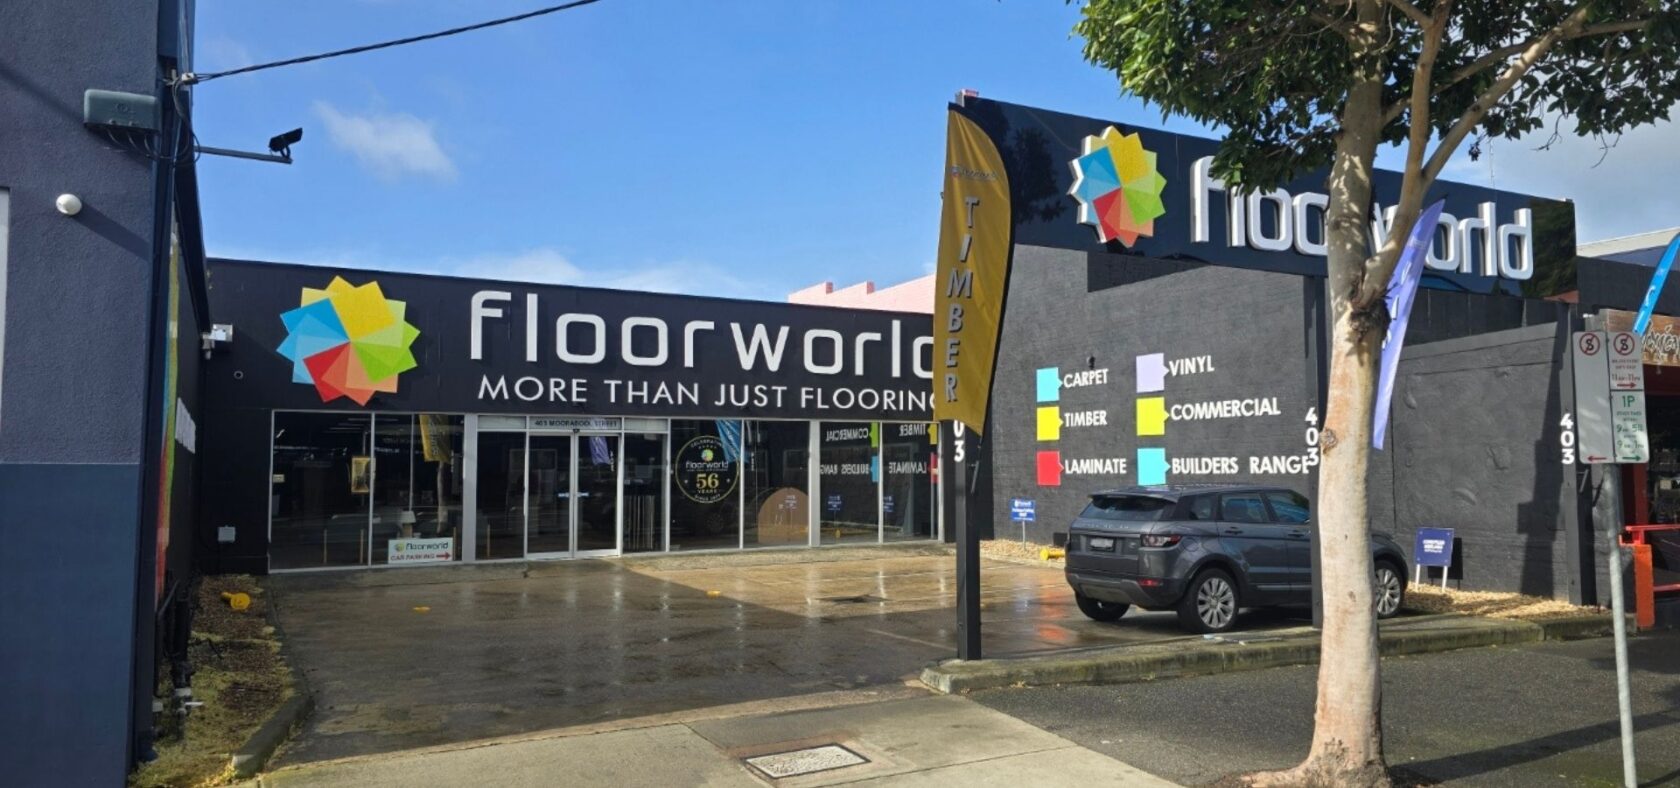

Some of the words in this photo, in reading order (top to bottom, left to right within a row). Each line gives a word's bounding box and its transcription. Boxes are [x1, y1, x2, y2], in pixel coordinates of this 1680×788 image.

[945, 196, 980, 403] TIMBER
[1169, 355, 1214, 376] VINYL
[1063, 368, 1109, 388] CARPET
[478, 375, 588, 403] MORE
[604, 379, 702, 406] THAN
[713, 382, 788, 407] JUST
[800, 386, 935, 411] FLOORIN
[1622, 395, 1635, 408] 1P
[1064, 410, 1107, 427] TIMBER
[1169, 397, 1281, 421] COMMERCIAL
[1304, 407, 1319, 466] 403
[1560, 413, 1574, 464] 403
[1065, 458, 1127, 475] LAMINATE
[1172, 457, 1239, 475] BUILDERS
[696, 473, 719, 489] 56
